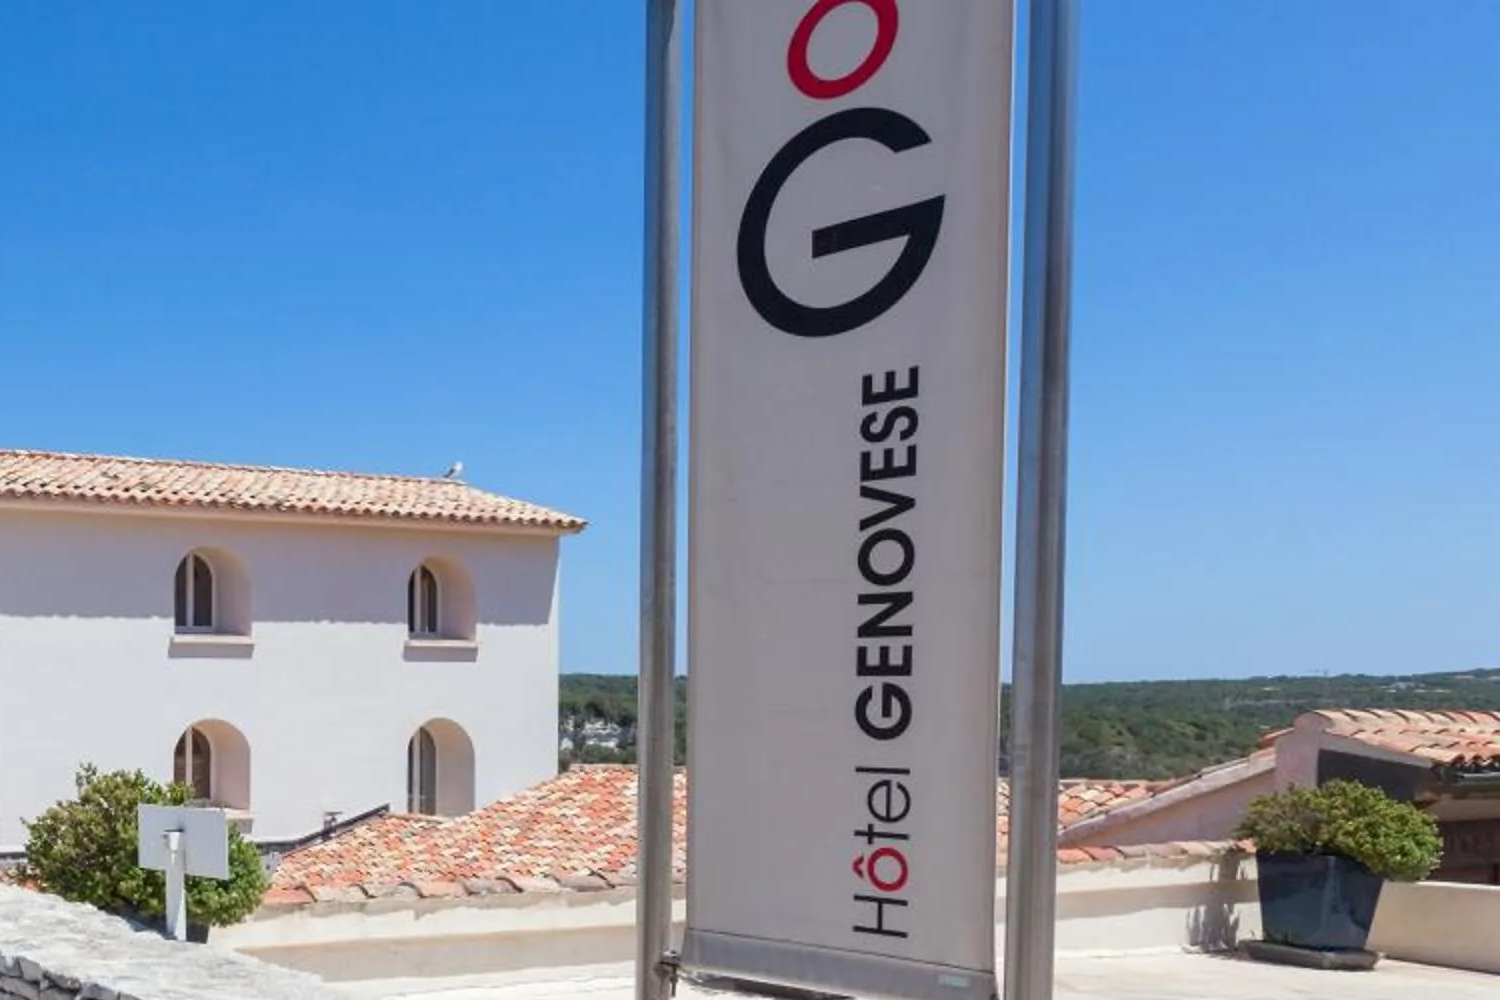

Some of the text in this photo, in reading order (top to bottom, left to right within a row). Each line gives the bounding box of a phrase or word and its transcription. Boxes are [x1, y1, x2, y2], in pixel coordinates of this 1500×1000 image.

[737, 107, 946, 338] G
[853, 366, 919, 938] Hôtel GENOVESE
